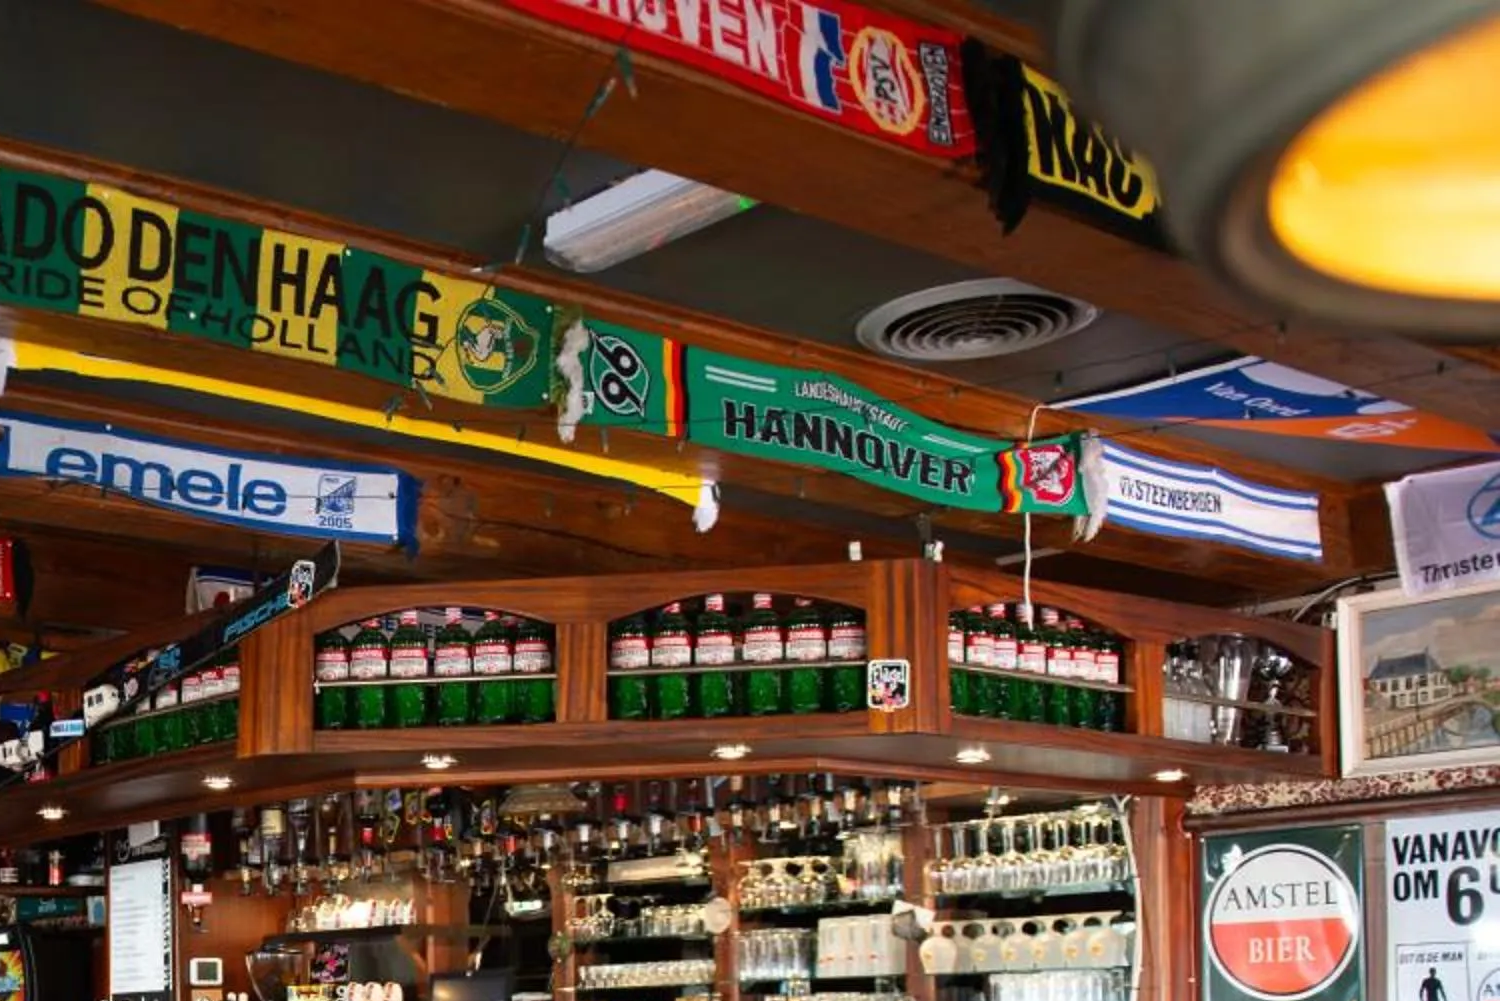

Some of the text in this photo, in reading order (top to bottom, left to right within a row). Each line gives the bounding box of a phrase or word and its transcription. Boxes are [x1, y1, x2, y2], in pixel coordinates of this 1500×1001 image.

[127, 207, 259, 307] DEN
[271, 242, 442, 350] HAAG
[121, 285, 195, 321] OF
[200, 307, 438, 381] HOLLAND
[721, 398, 975, 496] HANNOVER
[317, 515, 354, 529] 2005
[1222, 880, 1339, 913] AMSTEL
[1393, 869, 1440, 902] OM
[1446, 865, 1485, 927] 6
[1248, 935, 1317, 965] BIER
[1441, 950, 1464, 963] MAN
